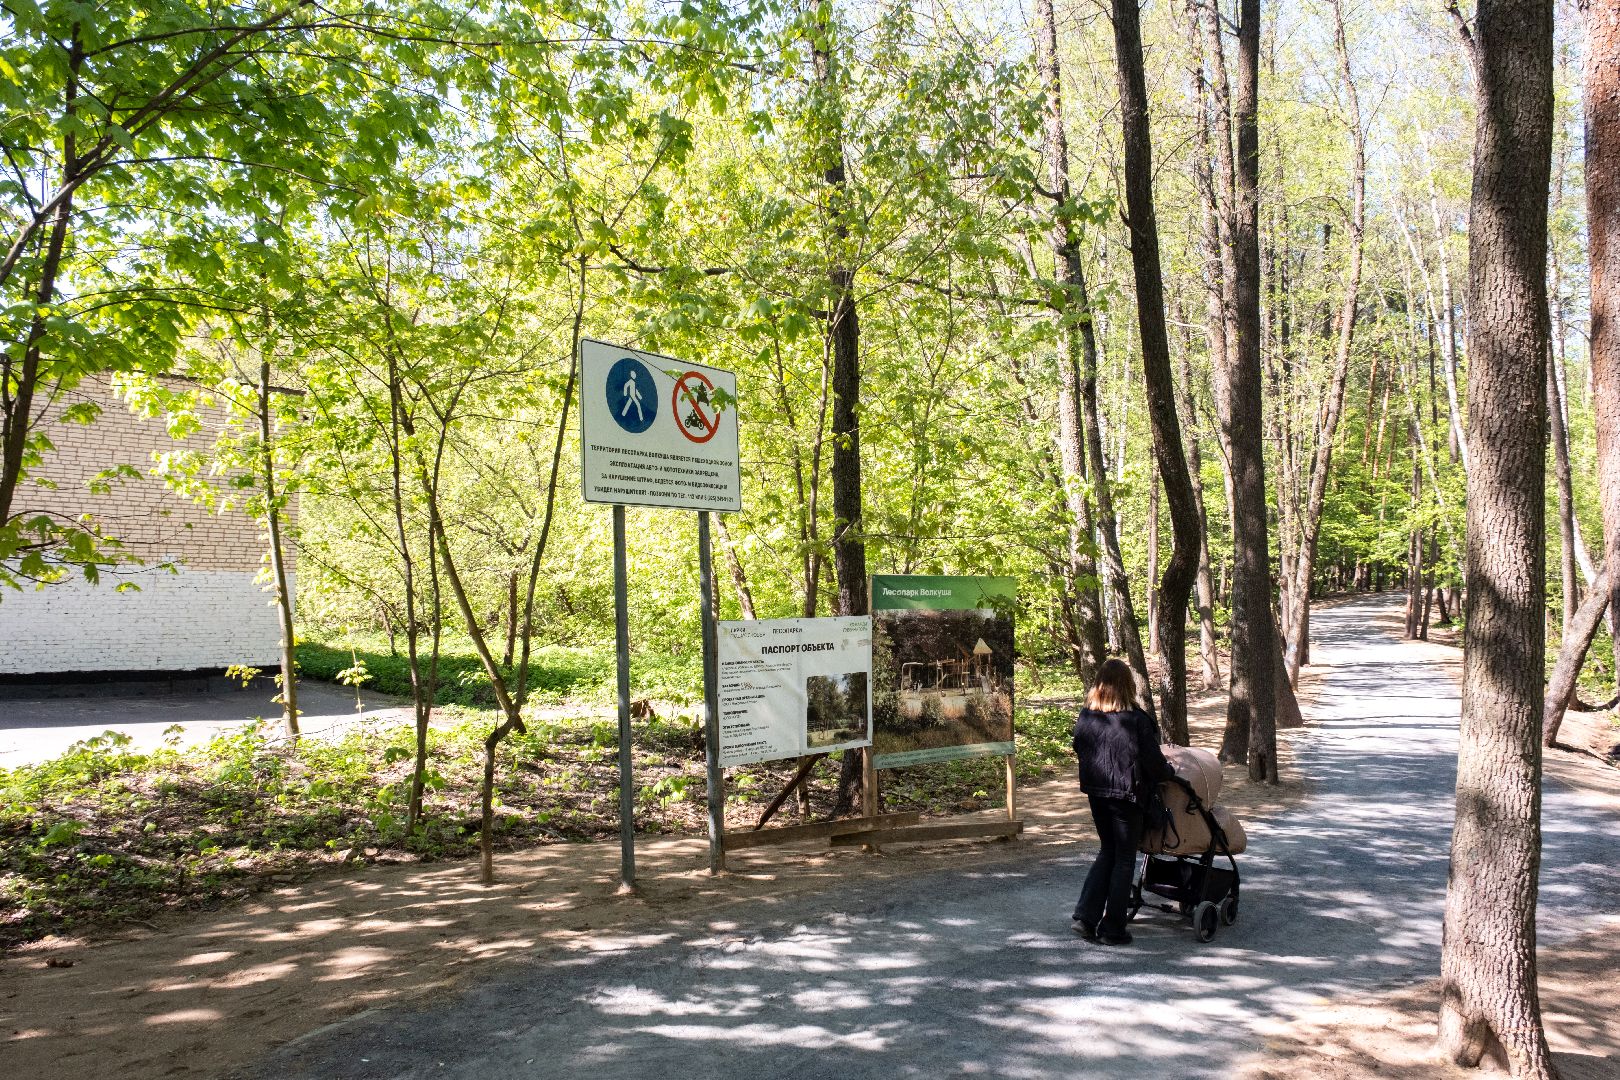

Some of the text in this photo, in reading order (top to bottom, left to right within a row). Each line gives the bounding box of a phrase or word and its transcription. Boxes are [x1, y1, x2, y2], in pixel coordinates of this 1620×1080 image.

[590, 444, 621, 454] ТЕРРИТОРИЯ
[621, 448, 648, 458] ЛЕСОПАРКА
[669, 453, 691, 462] ЯВЛЯЕТСЯ
[608, 474, 636, 482] НАРУШЕНИЕ
[594, 485, 613, 493] УВИДЕЛ
[882, 587, 952, 598] Лесопарк Волкуша
[761, 642, 835, 655] ПАСПОРТ ОБЪЕКТА
